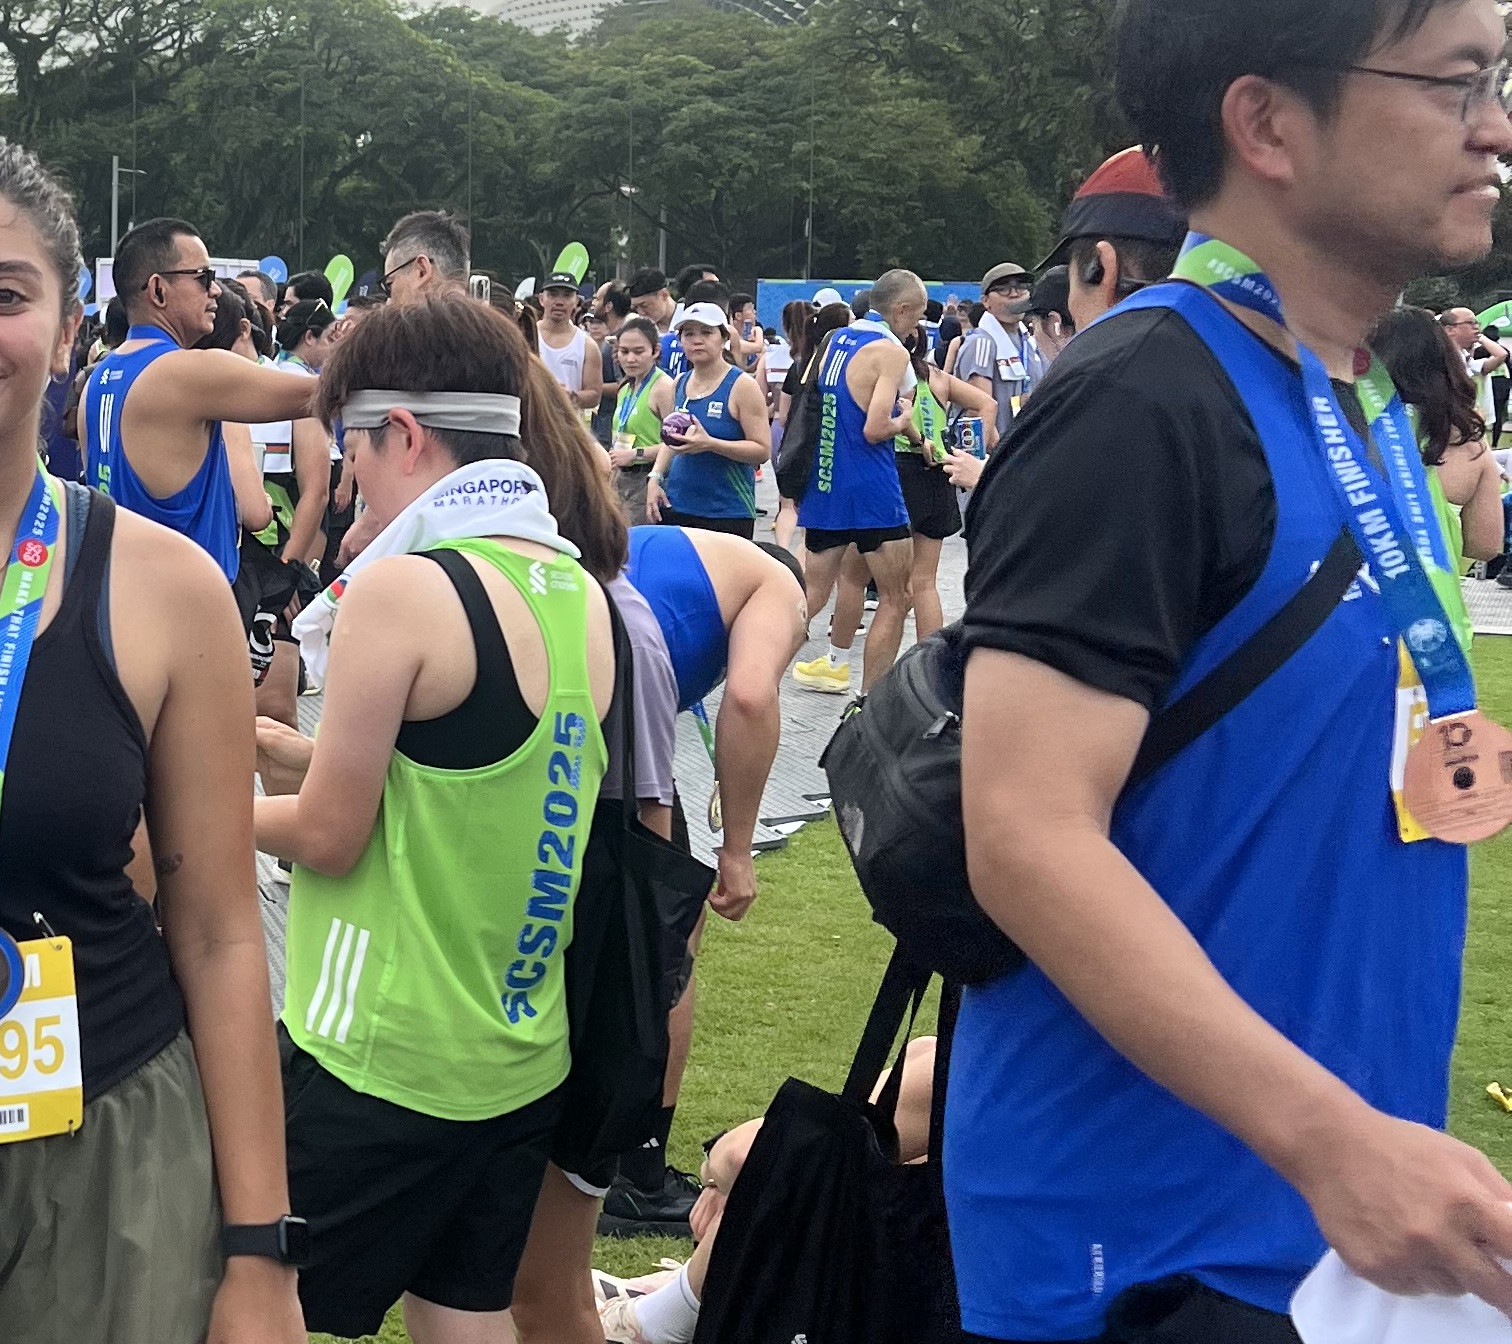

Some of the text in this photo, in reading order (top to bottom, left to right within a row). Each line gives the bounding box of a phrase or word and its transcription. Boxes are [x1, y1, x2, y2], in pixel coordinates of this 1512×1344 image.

[817, 392, 837, 494] SCSM2025
[434, 496, 521, 508] MARATHO
[1311, 396, 1410, 580] 10KM FINISHER
[15, 570, 35, 606] MAKE
[7, 609, 25, 640] THAT
